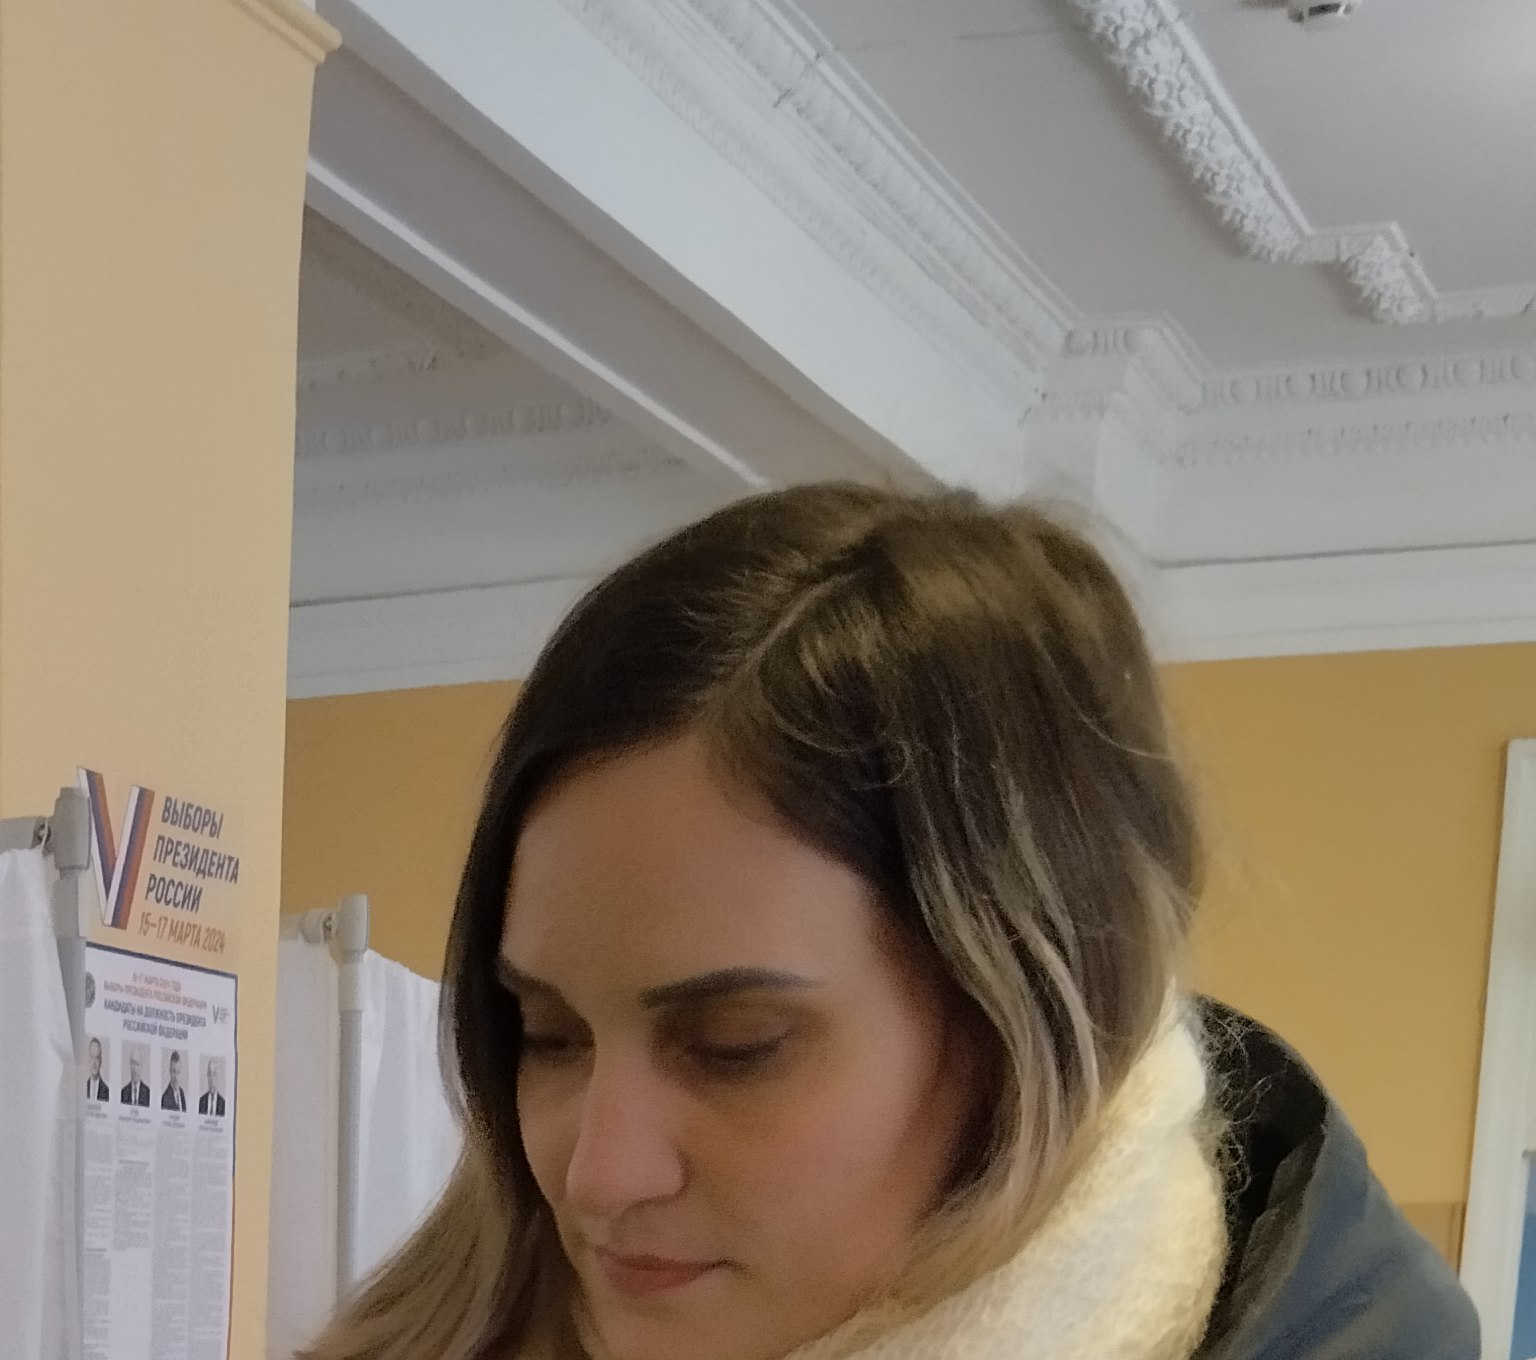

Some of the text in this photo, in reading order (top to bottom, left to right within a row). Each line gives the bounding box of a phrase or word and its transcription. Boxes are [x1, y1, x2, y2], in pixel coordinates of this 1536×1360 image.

[161, 796, 224, 839] ВЫБОРЫ
[152, 834, 240, 885] ПРЕЗИДЕНТА
[144, 873, 203, 914] РОССИИ
[167, 918, 202, 948] МАРТА
[202, 926, 226, 953] 2024
